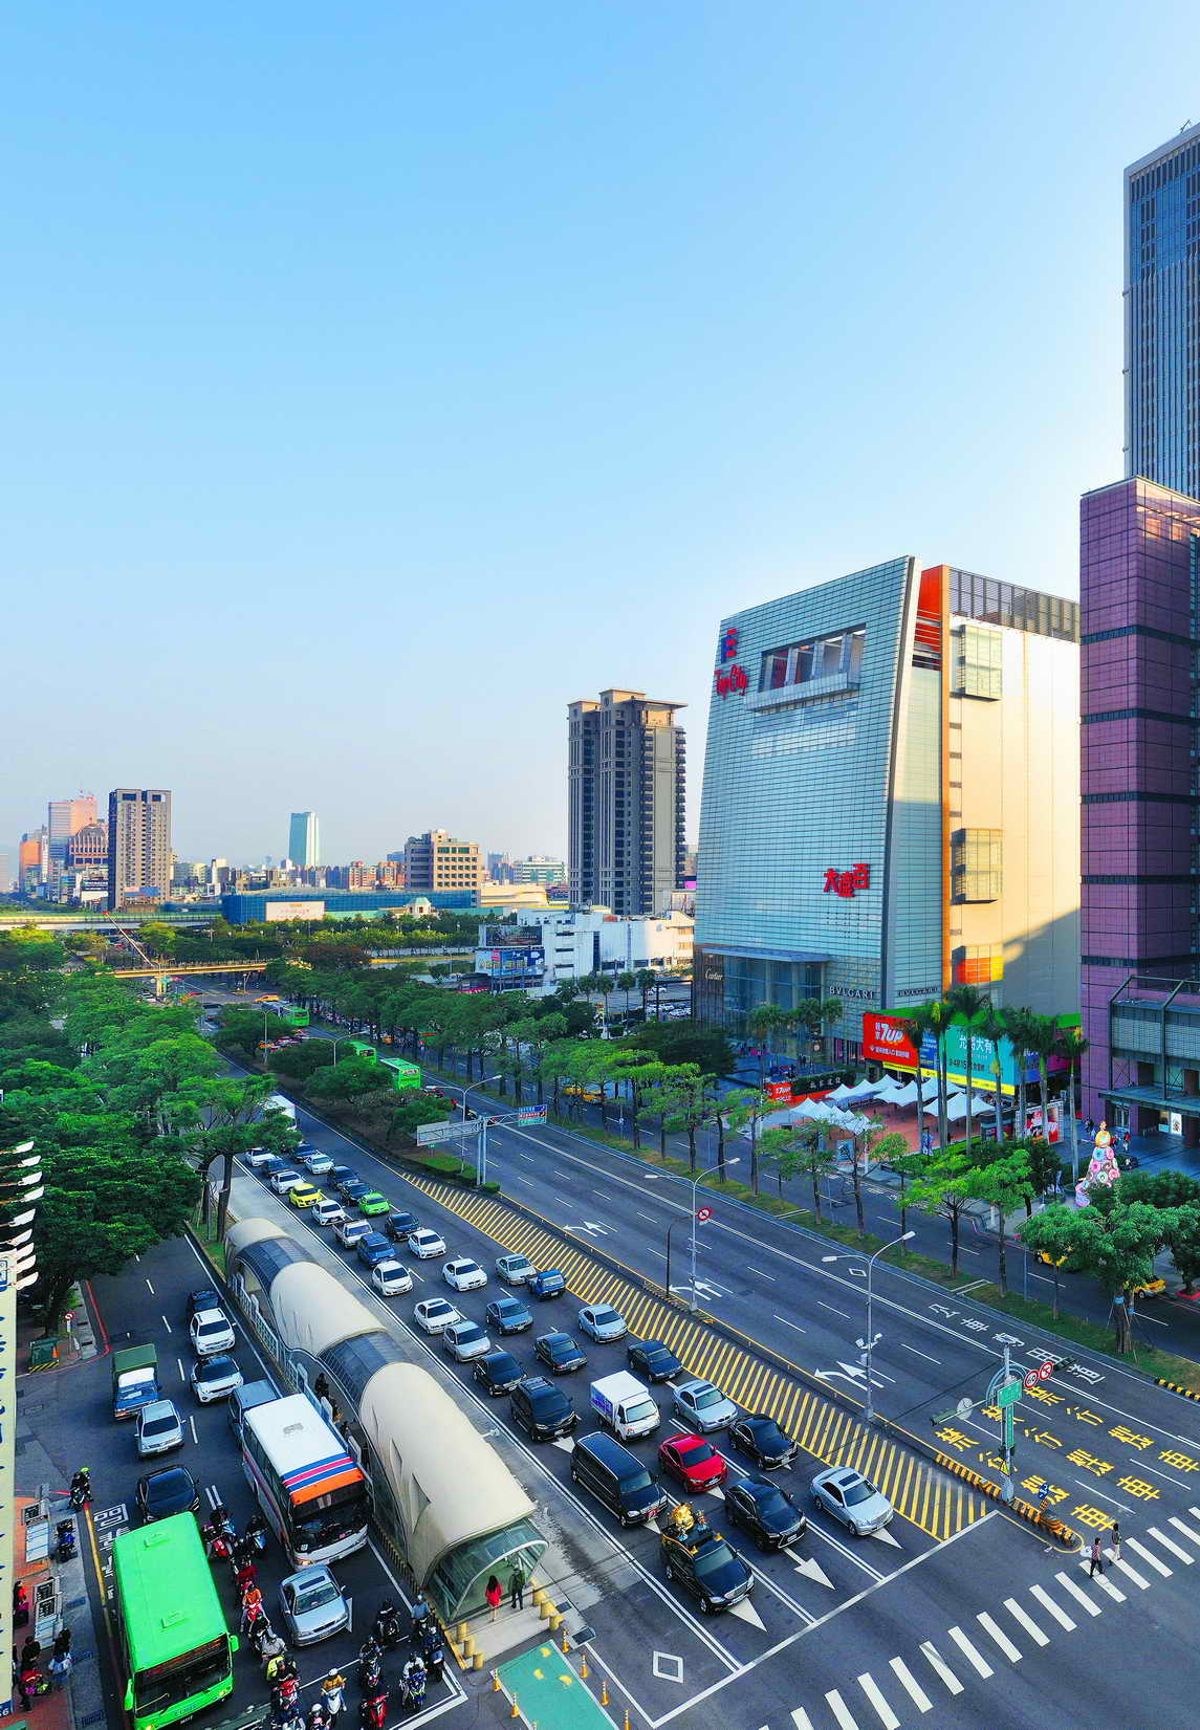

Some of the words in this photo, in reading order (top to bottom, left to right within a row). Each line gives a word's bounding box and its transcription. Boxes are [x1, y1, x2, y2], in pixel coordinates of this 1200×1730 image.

[829, 985, 874, 999] BVLGARI
[1024, 1386, 1200, 1472] 禁行機車
